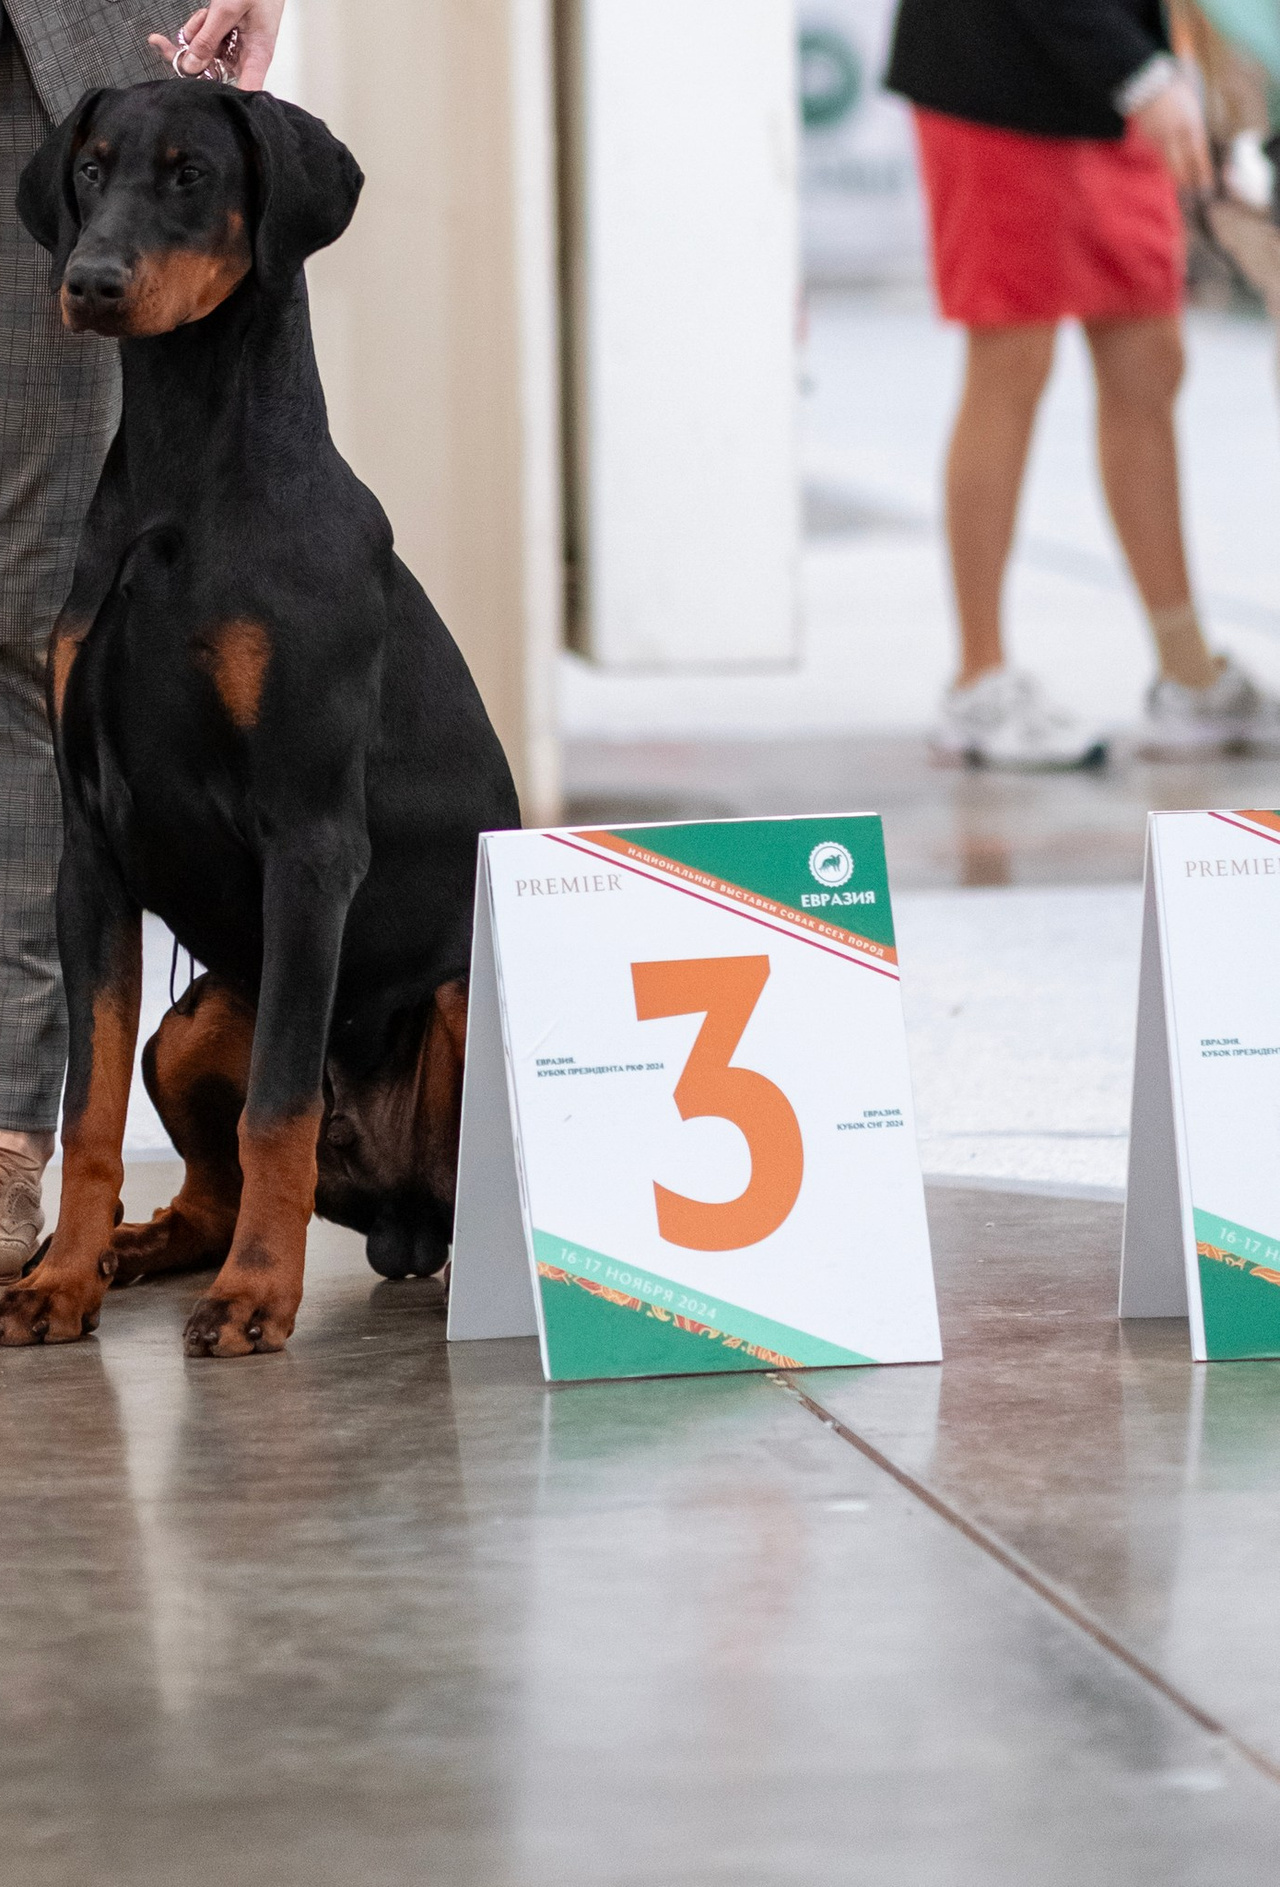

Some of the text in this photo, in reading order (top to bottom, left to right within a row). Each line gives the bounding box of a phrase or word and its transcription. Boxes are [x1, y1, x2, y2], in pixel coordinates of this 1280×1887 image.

[1184, 857, 1280, 878] PREMIE
[515, 874, 622, 897] PREMIER
[627, 846, 885, 957] НАЦИОНАЛЬНЫЕ ВЫСТАВКИ СОБАК ВСЕХ ПОРОД
[800, 890, 875, 908] ЕВРАЗИЯ
[1201, 1050, 1231, 1058] КУБОК
[537, 1069, 566, 1077] КУБОК
[567, 1066, 624, 1076] ПРЕЗИДЕНТА
[630, 954, 804, 1252] 3
[836, 1122, 865, 1130] КУБОК
[1220, 1227, 1261, 1253] 16-17
[560, 1248, 718, 1320] 16-17 НОЯБРЯ 2024
